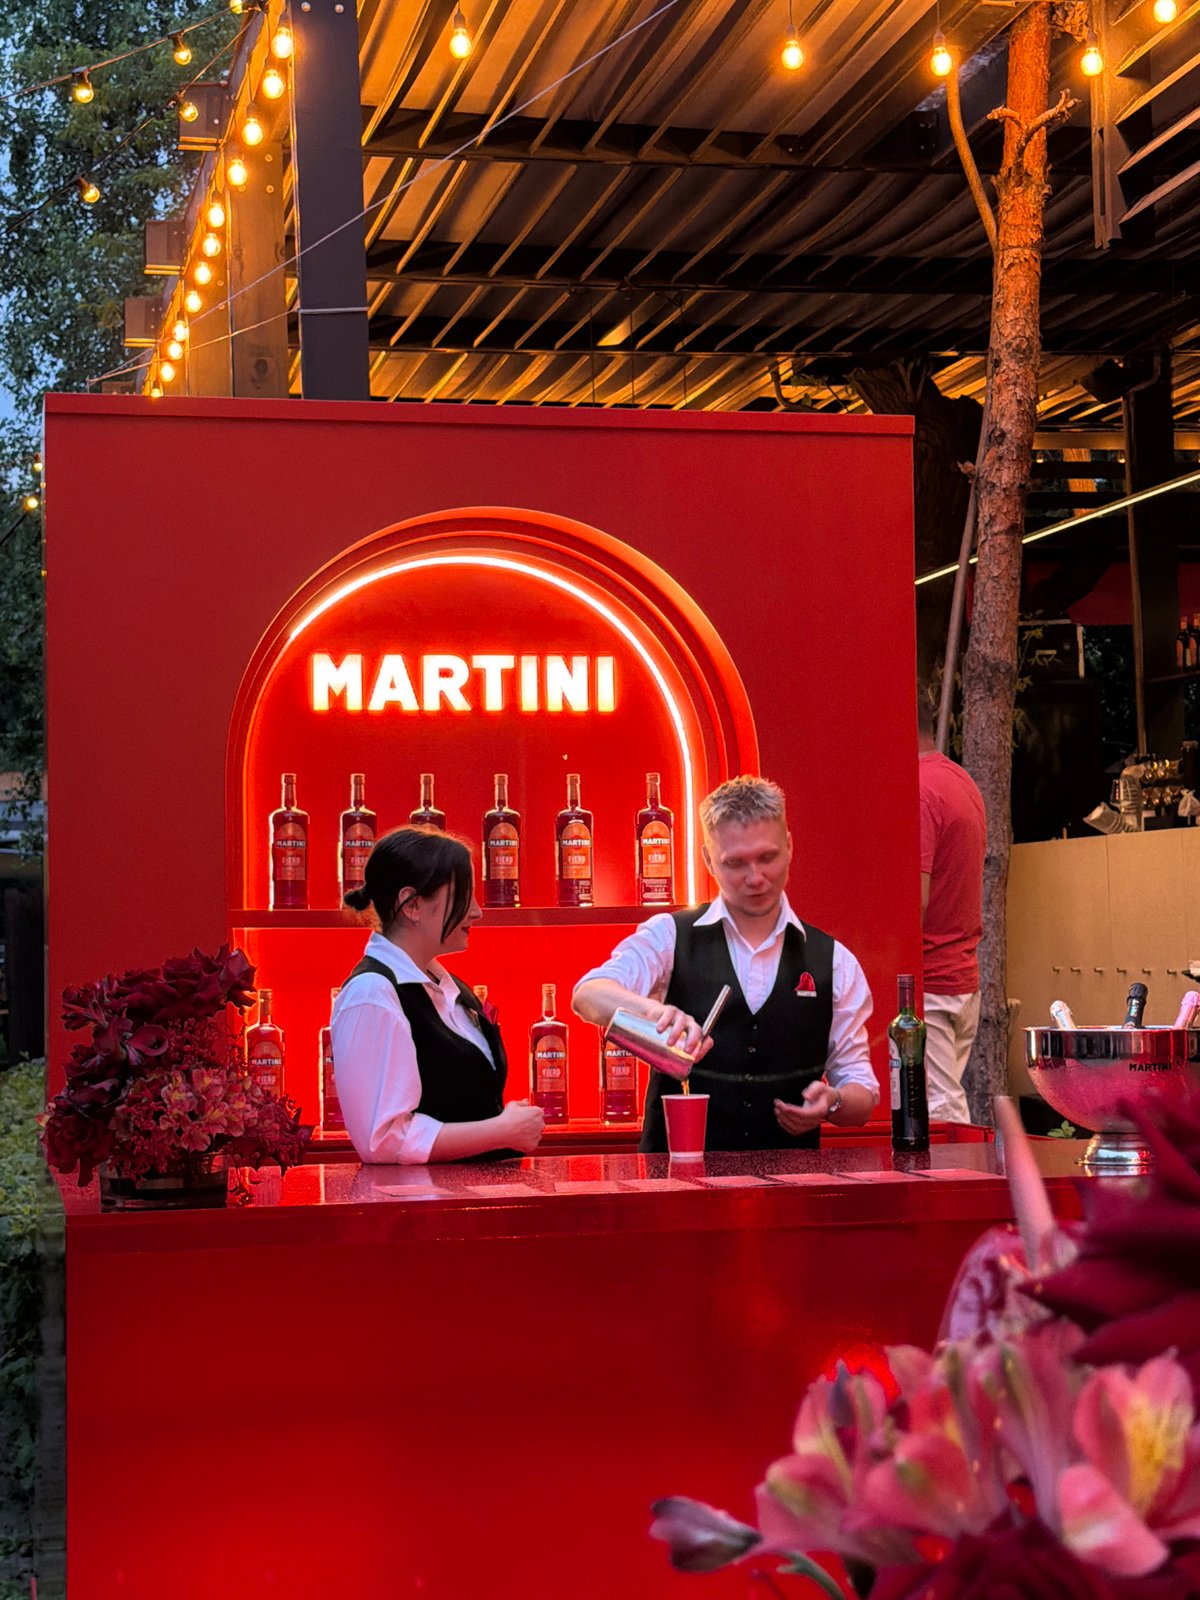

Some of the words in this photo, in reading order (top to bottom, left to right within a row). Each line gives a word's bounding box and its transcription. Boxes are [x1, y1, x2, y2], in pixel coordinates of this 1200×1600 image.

[313, 654, 614, 712] MARTINI
[276, 840, 305, 848] MARTINI
[489, 839, 517, 847] MARTINI
[562, 838, 590, 847] MARTINI
[536, 1051, 566, 1059] MARTINI
[1129, 1062, 1171, 1072] MARTINI
